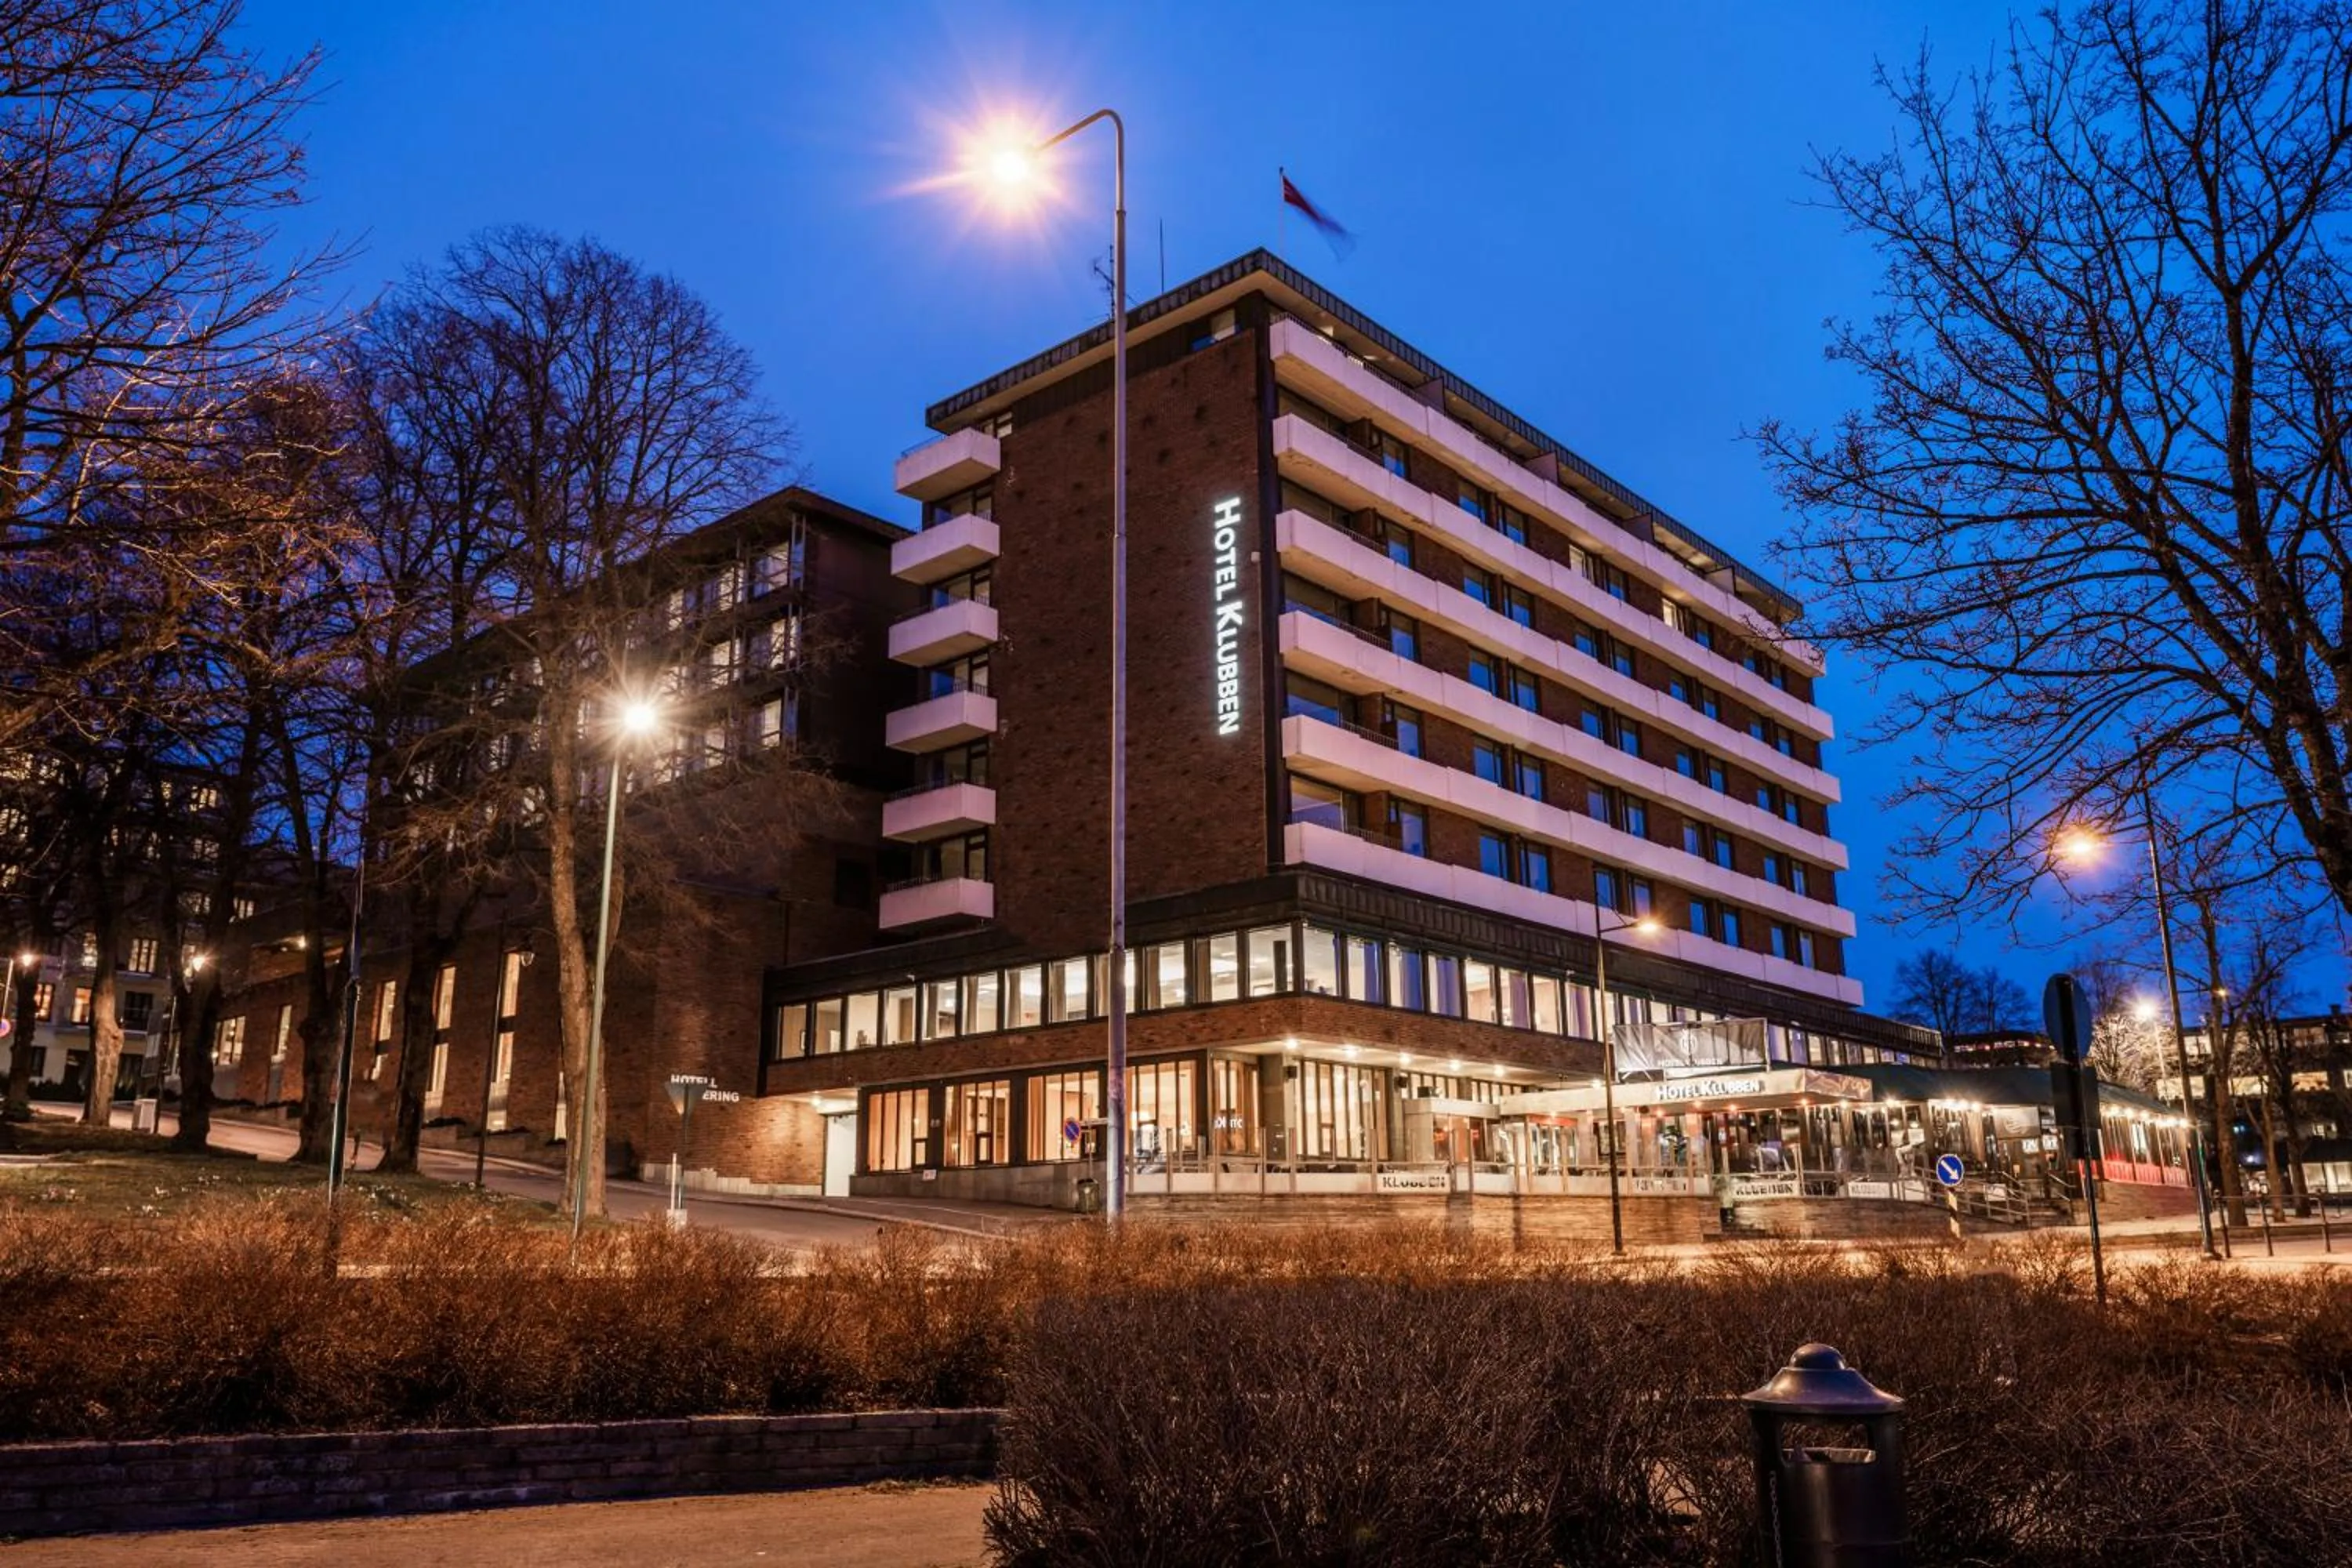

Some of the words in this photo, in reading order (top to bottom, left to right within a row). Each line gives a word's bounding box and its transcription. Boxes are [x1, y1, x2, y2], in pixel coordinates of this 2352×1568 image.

[1214, 497, 1241, 601] HOTEL
[1216, 601, 1243, 735] KLUBBEN
[702, 1090, 740, 1103] ERING
[1657, 1084, 1700, 1100] HOTEL
[1701, 1080, 1762, 1096] KLUBBEN
